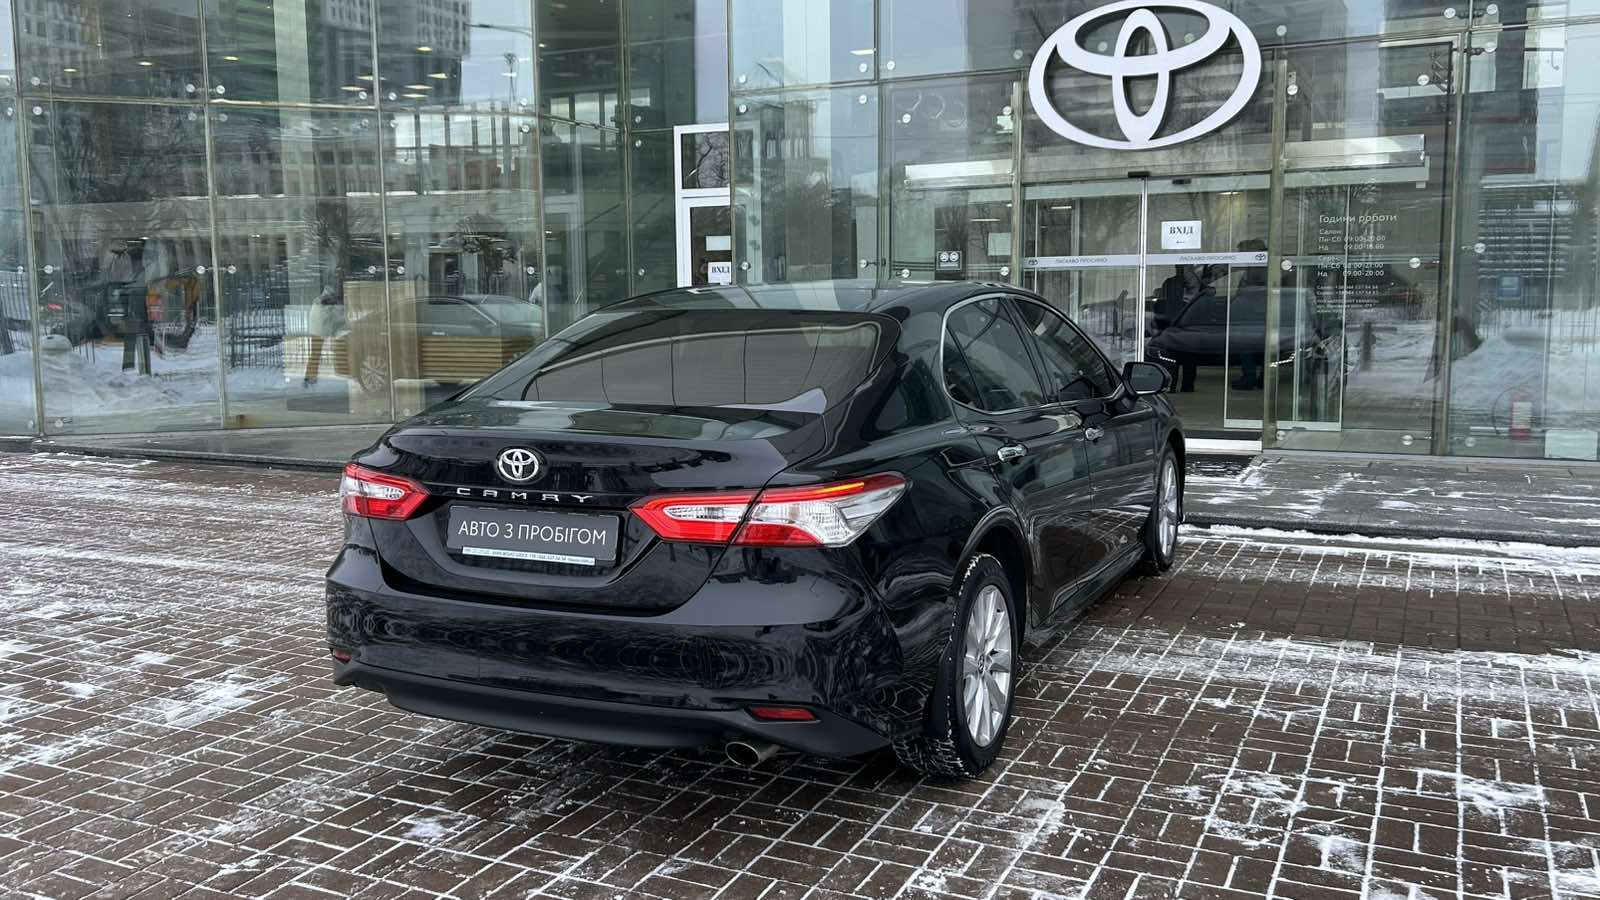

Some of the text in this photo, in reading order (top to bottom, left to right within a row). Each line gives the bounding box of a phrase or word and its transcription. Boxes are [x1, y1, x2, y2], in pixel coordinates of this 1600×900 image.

[1319, 213, 1397, 224] Години роботи
[1169, 226, 1194, 235] ВХІД
[456, 487, 594, 503] CAMRY
[457, 520, 500, 538] АВТО
[518, 524, 607, 545] ПРОБІГОМ
